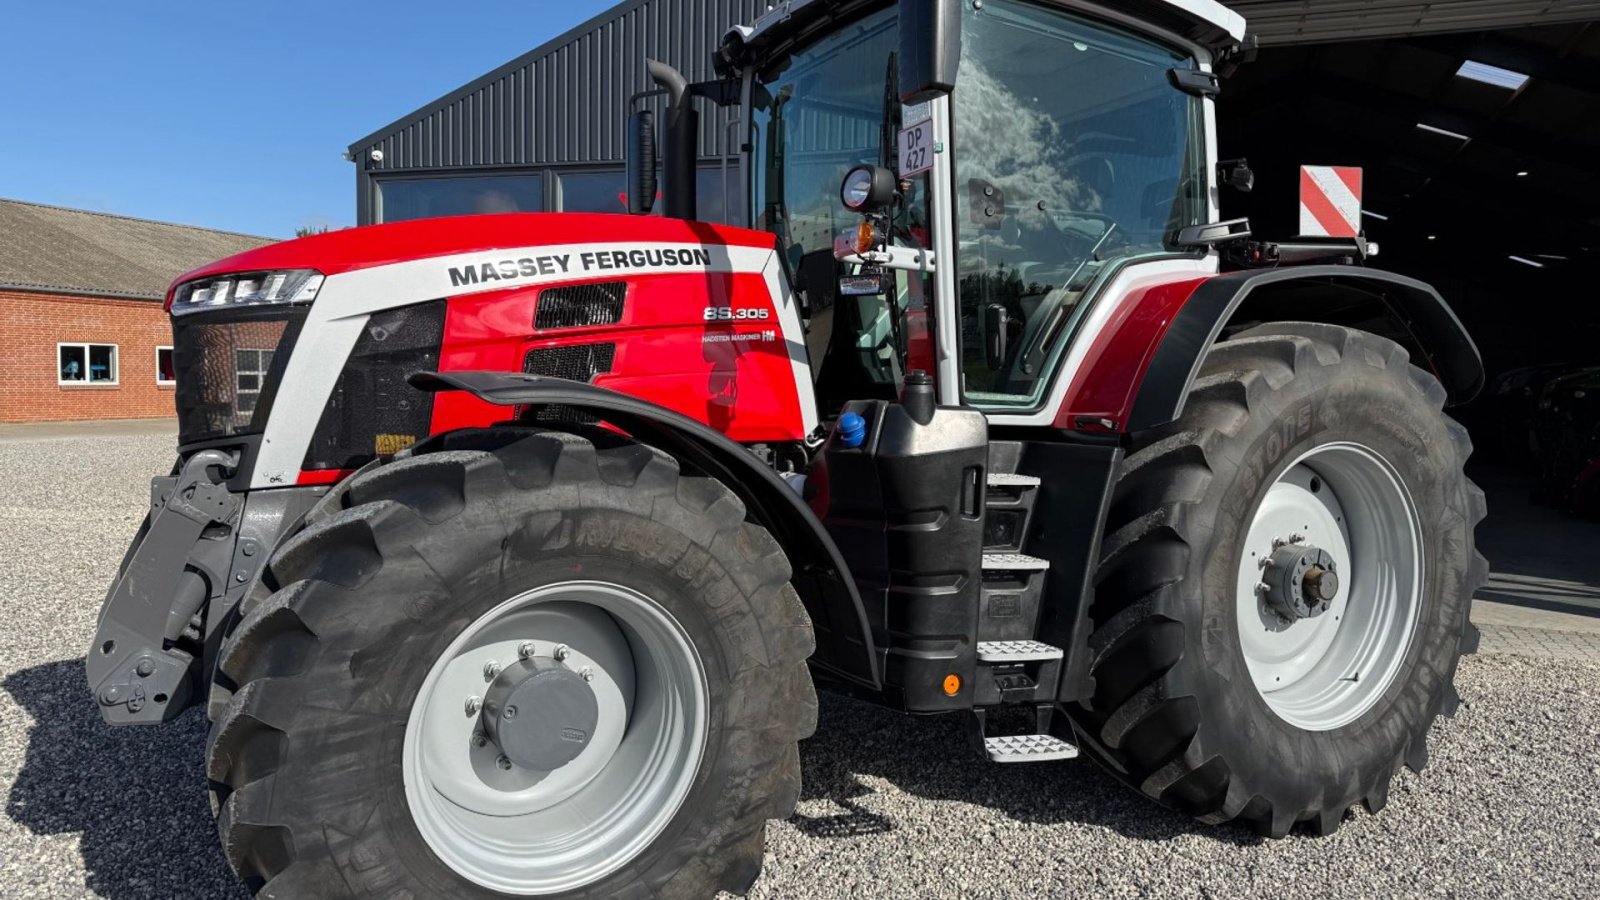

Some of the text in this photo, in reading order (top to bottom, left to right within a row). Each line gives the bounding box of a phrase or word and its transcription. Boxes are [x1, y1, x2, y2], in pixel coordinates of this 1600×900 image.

[907, 128, 922, 150] DP
[906, 147, 926, 171] 427
[448, 249, 711, 287] MASSEY FERGUSON
[703, 307, 769, 320] 8S.305
